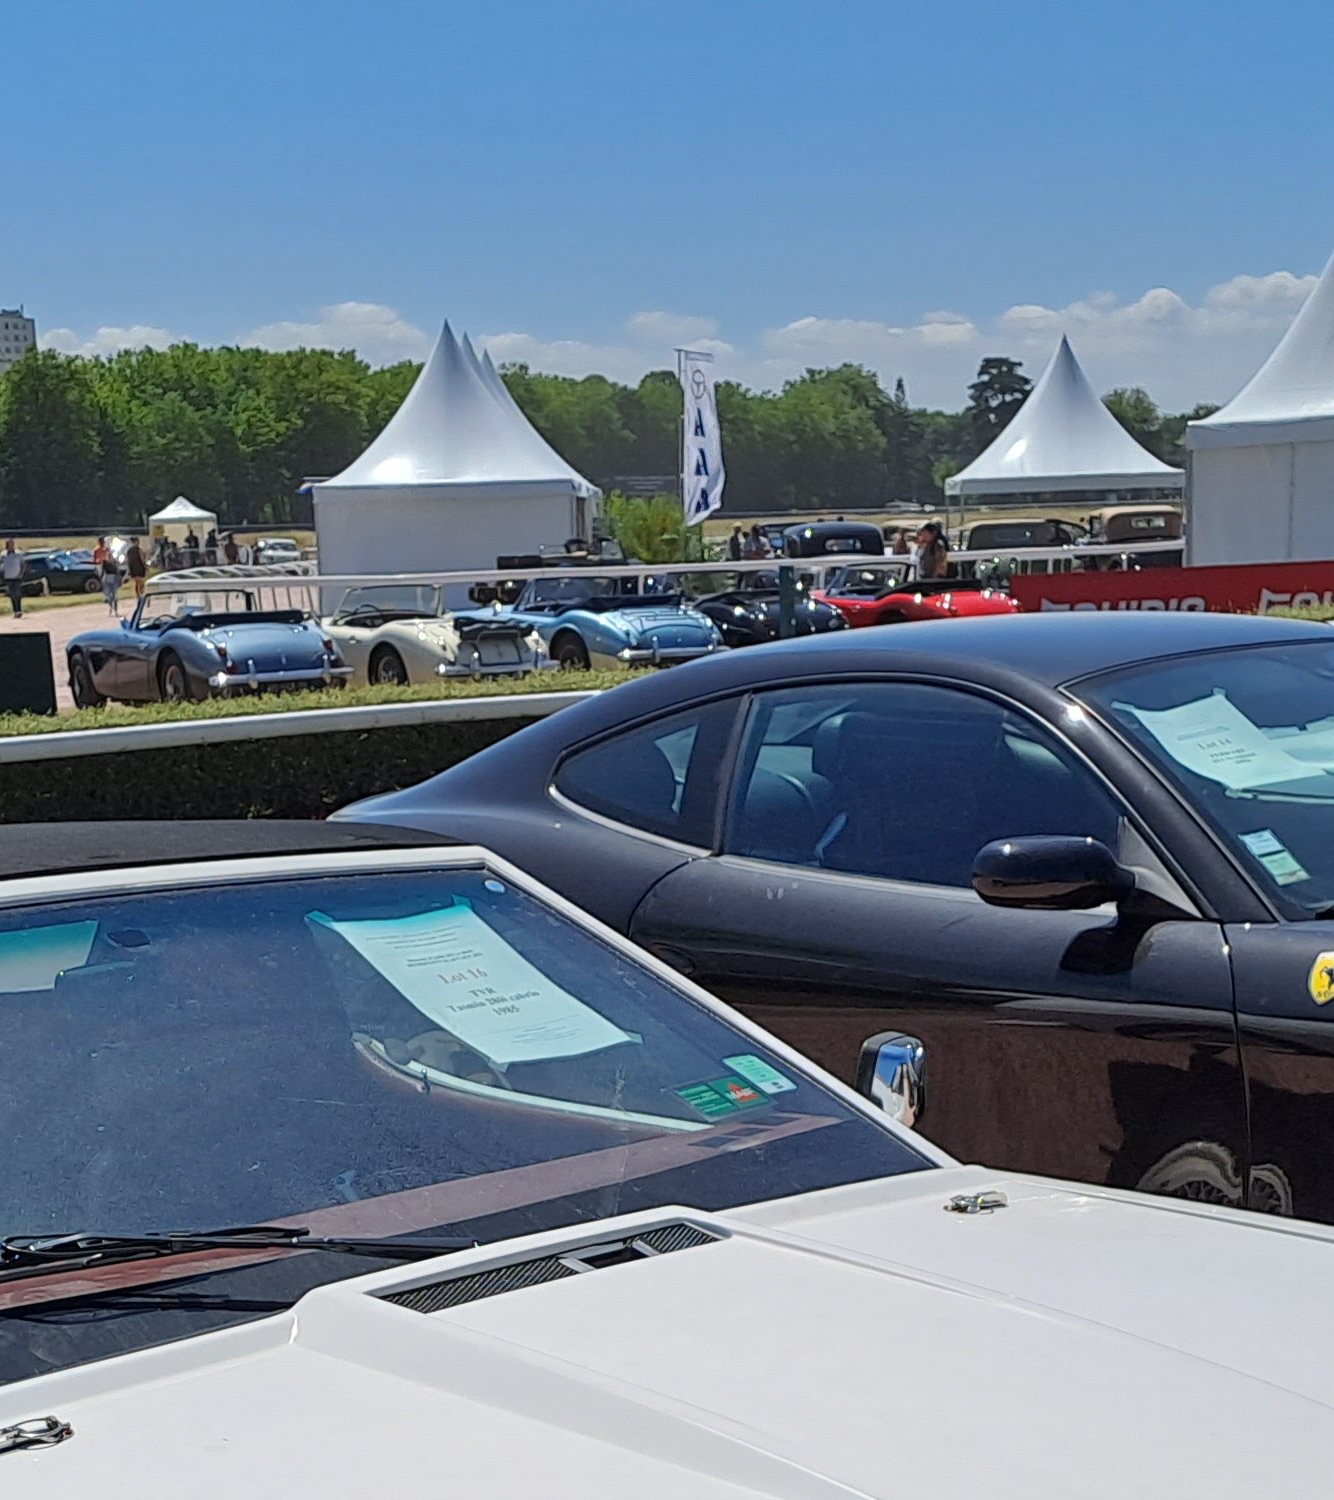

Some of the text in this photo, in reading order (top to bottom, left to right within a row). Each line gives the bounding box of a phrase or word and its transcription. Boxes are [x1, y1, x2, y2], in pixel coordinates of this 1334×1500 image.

[437, 967, 488, 984] Lot 16
[468, 985, 498, 998] TVR
